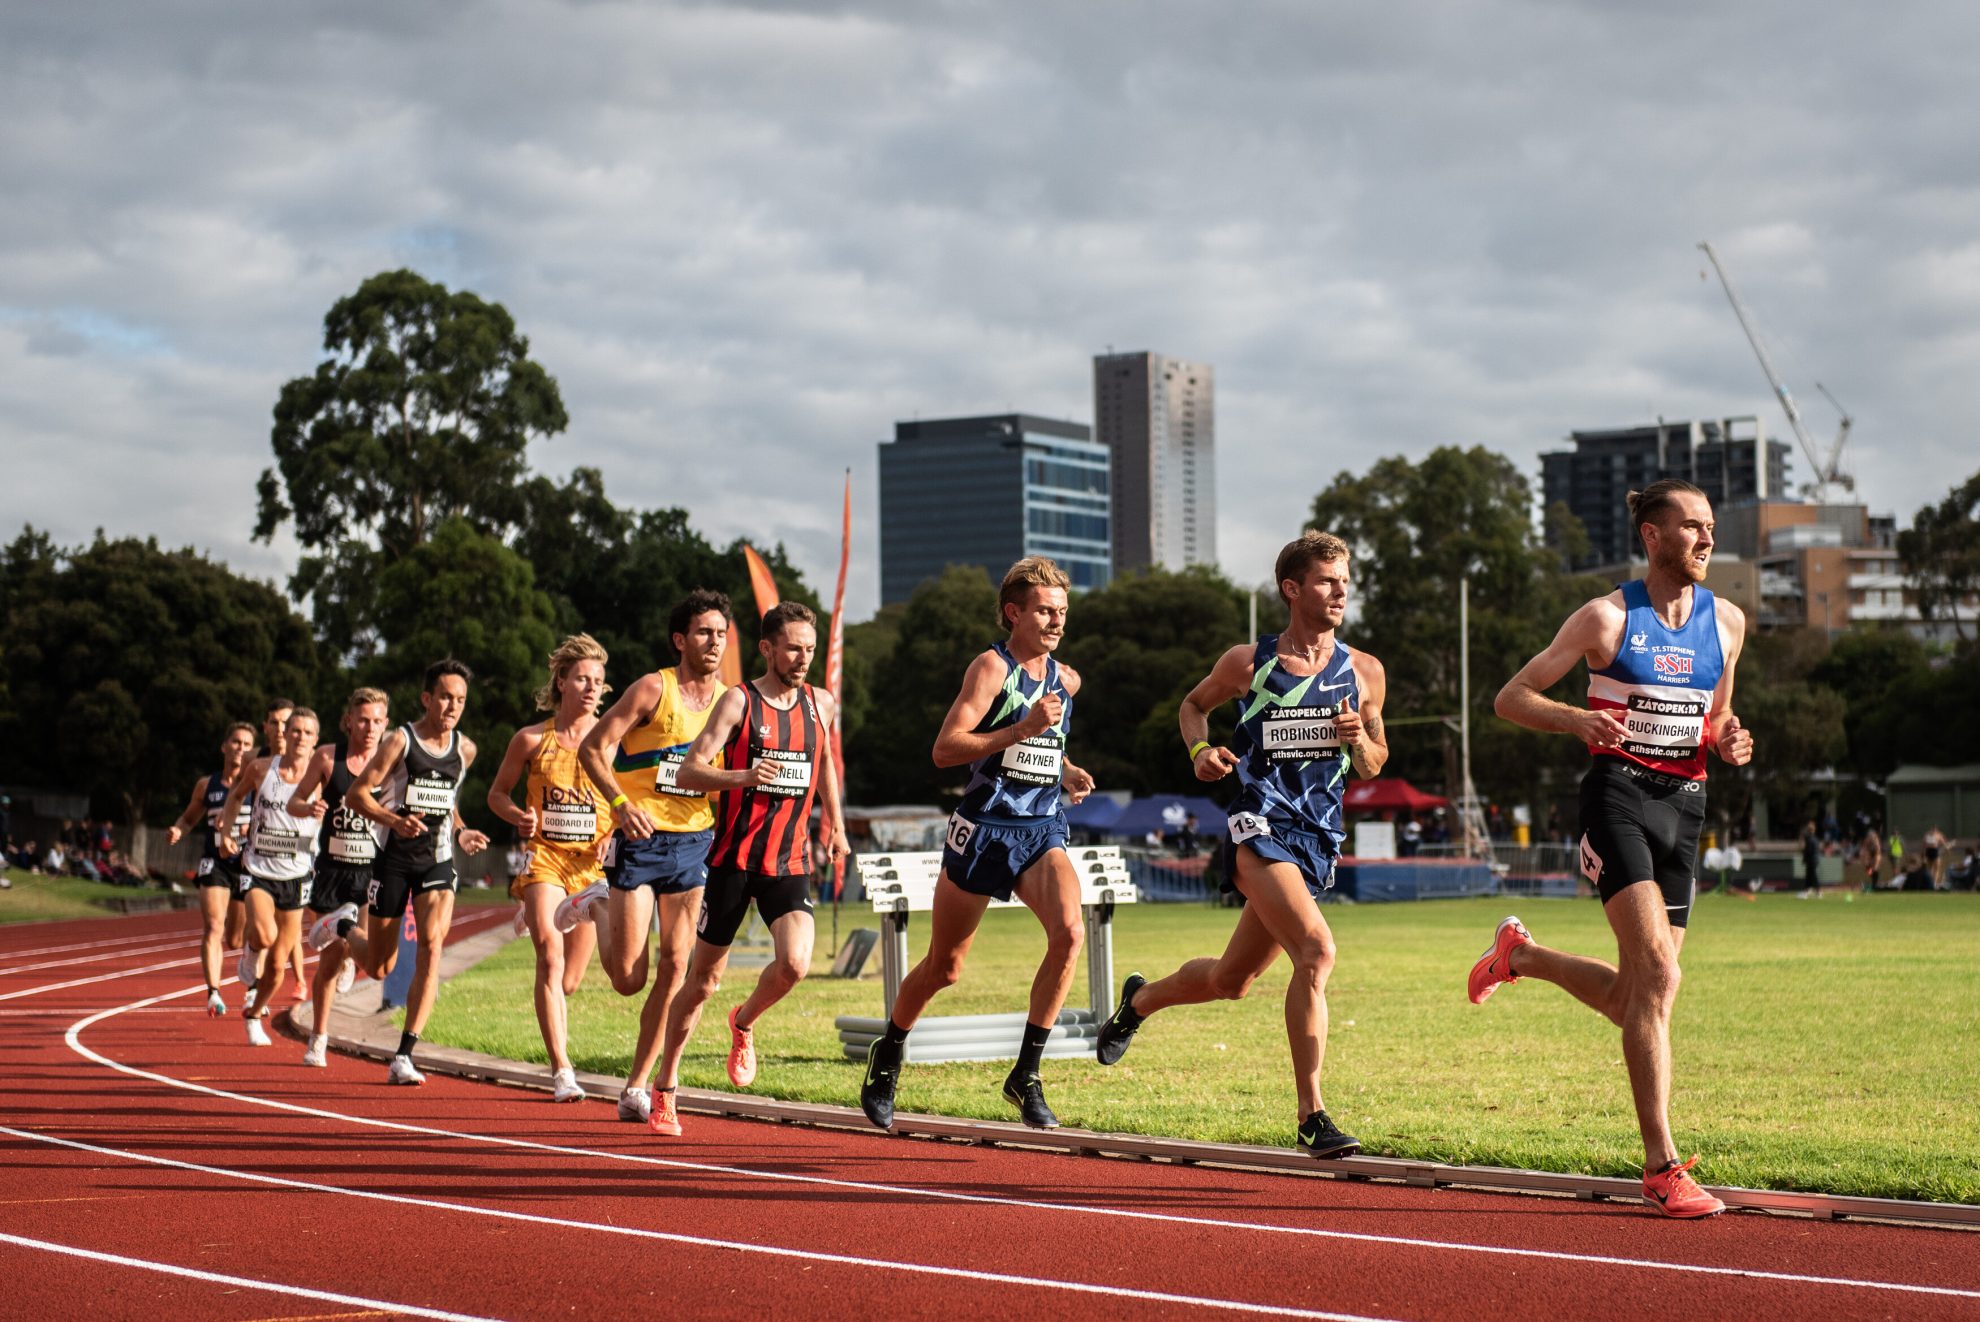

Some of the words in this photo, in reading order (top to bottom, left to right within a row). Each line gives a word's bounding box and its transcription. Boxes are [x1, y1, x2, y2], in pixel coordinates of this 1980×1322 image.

[1663, 646, 1695, 656] STEPHENS
[1654, 653, 1693, 675] SSH
[1657, 675, 1690, 683] HARRIERS
[1271, 707, 1331, 719] ZÁTOPEK:10
[1636, 698, 1698, 715] ZÁTOPEK:10
[1270, 726, 1338, 742] ROBINSON
[1628, 719, 1699, 738] BUCKINGHAM
[1271, 749, 1333, 760] athsvic.org.au
[1629, 744, 1691, 759] athsvic.org.au
[1016, 751, 1055, 768] RAYNER
[1006, 770, 1054, 784] athsvic.org.au
[417, 791, 448, 803] WARING
[542, 785, 596, 808] IONA
[756, 784, 805, 796] athsvic.org.au
[544, 816, 582, 828] GODDARD
[1234, 817, 1257, 834] 19
[950, 820, 971, 848] 16
[257, 839, 297, 850] BUCHANAN
[344, 844, 364, 854] TALL
[1581, 845, 1596, 872] 4
